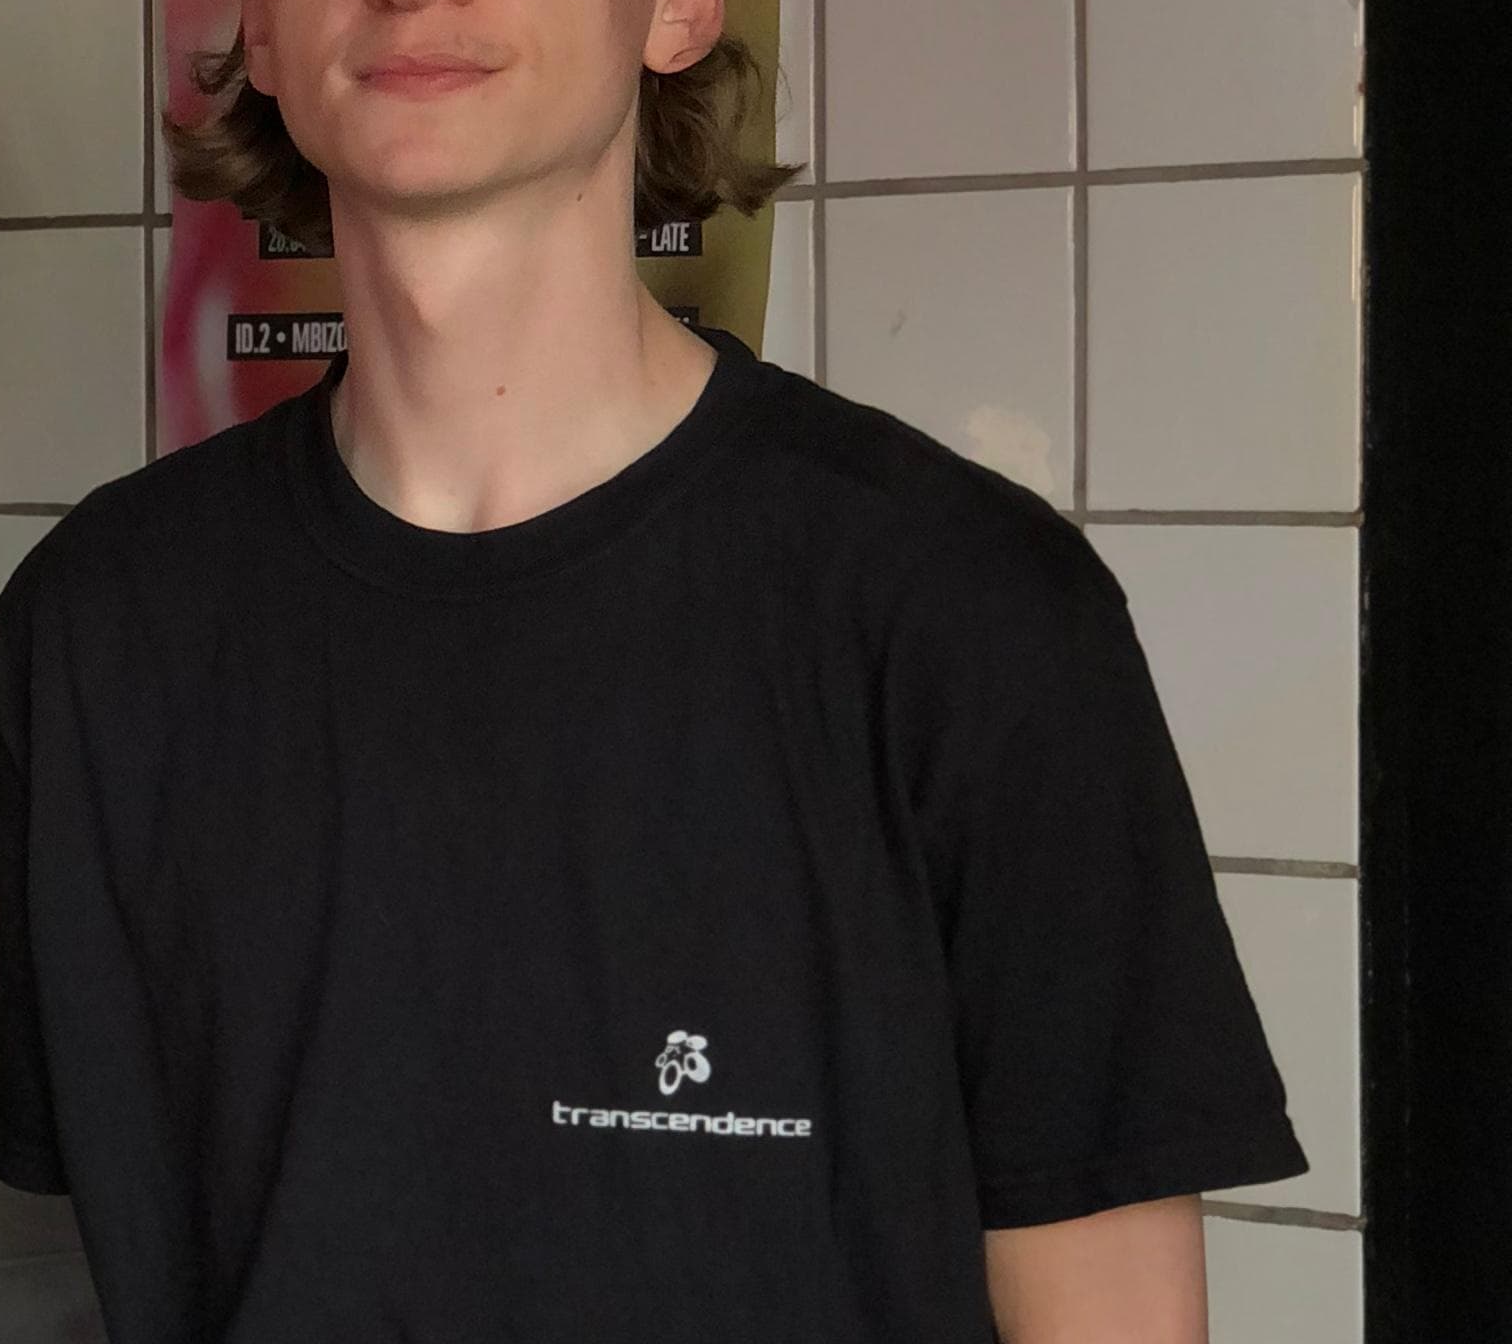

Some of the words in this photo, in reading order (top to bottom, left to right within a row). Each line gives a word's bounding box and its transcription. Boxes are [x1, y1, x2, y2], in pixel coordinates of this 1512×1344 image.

[651, 221, 691, 252] LATE
[235, 321, 271, 354] ID.2
[552, 1100, 812, 1137] transcendence
